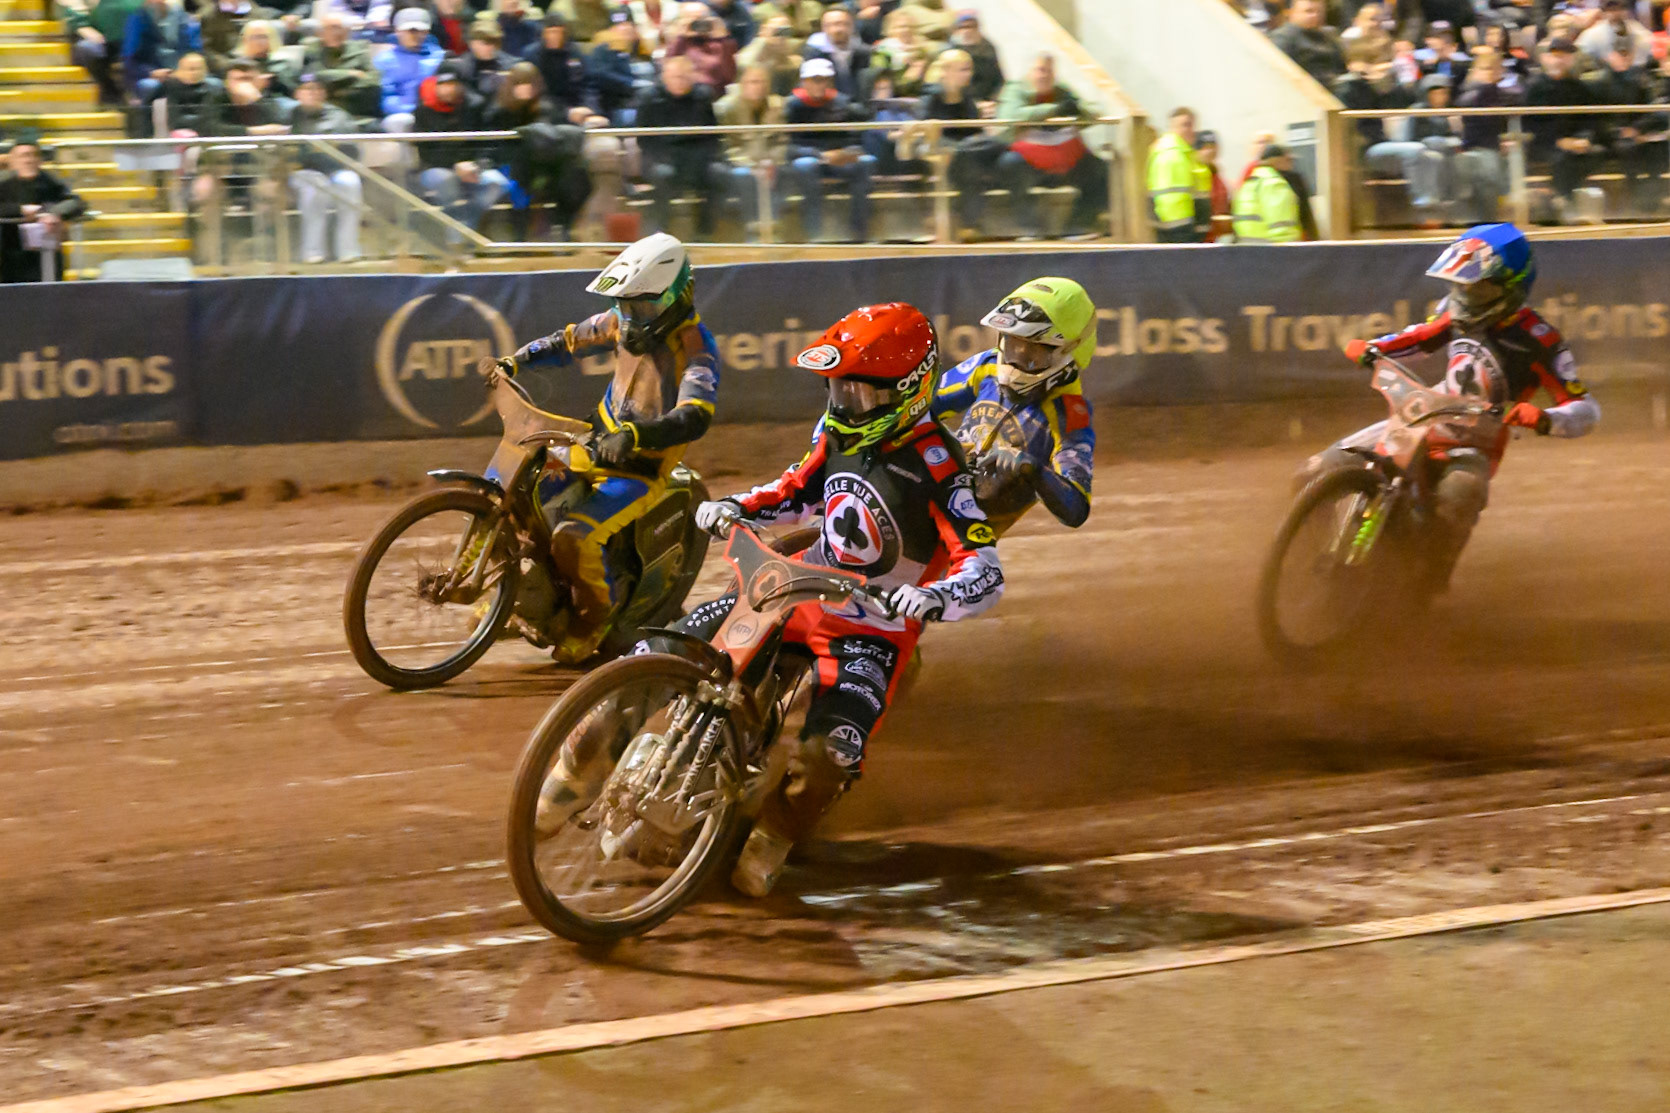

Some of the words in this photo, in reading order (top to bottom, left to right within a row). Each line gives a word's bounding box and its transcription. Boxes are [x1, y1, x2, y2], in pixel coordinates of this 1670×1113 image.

[896, 345, 937, 391] OAKLEY
[824, 479, 848, 502] ELLE
[852, 481, 873, 505] VUE
[870, 507, 896, 541] ACES
[695, 605, 730, 628] POINT
